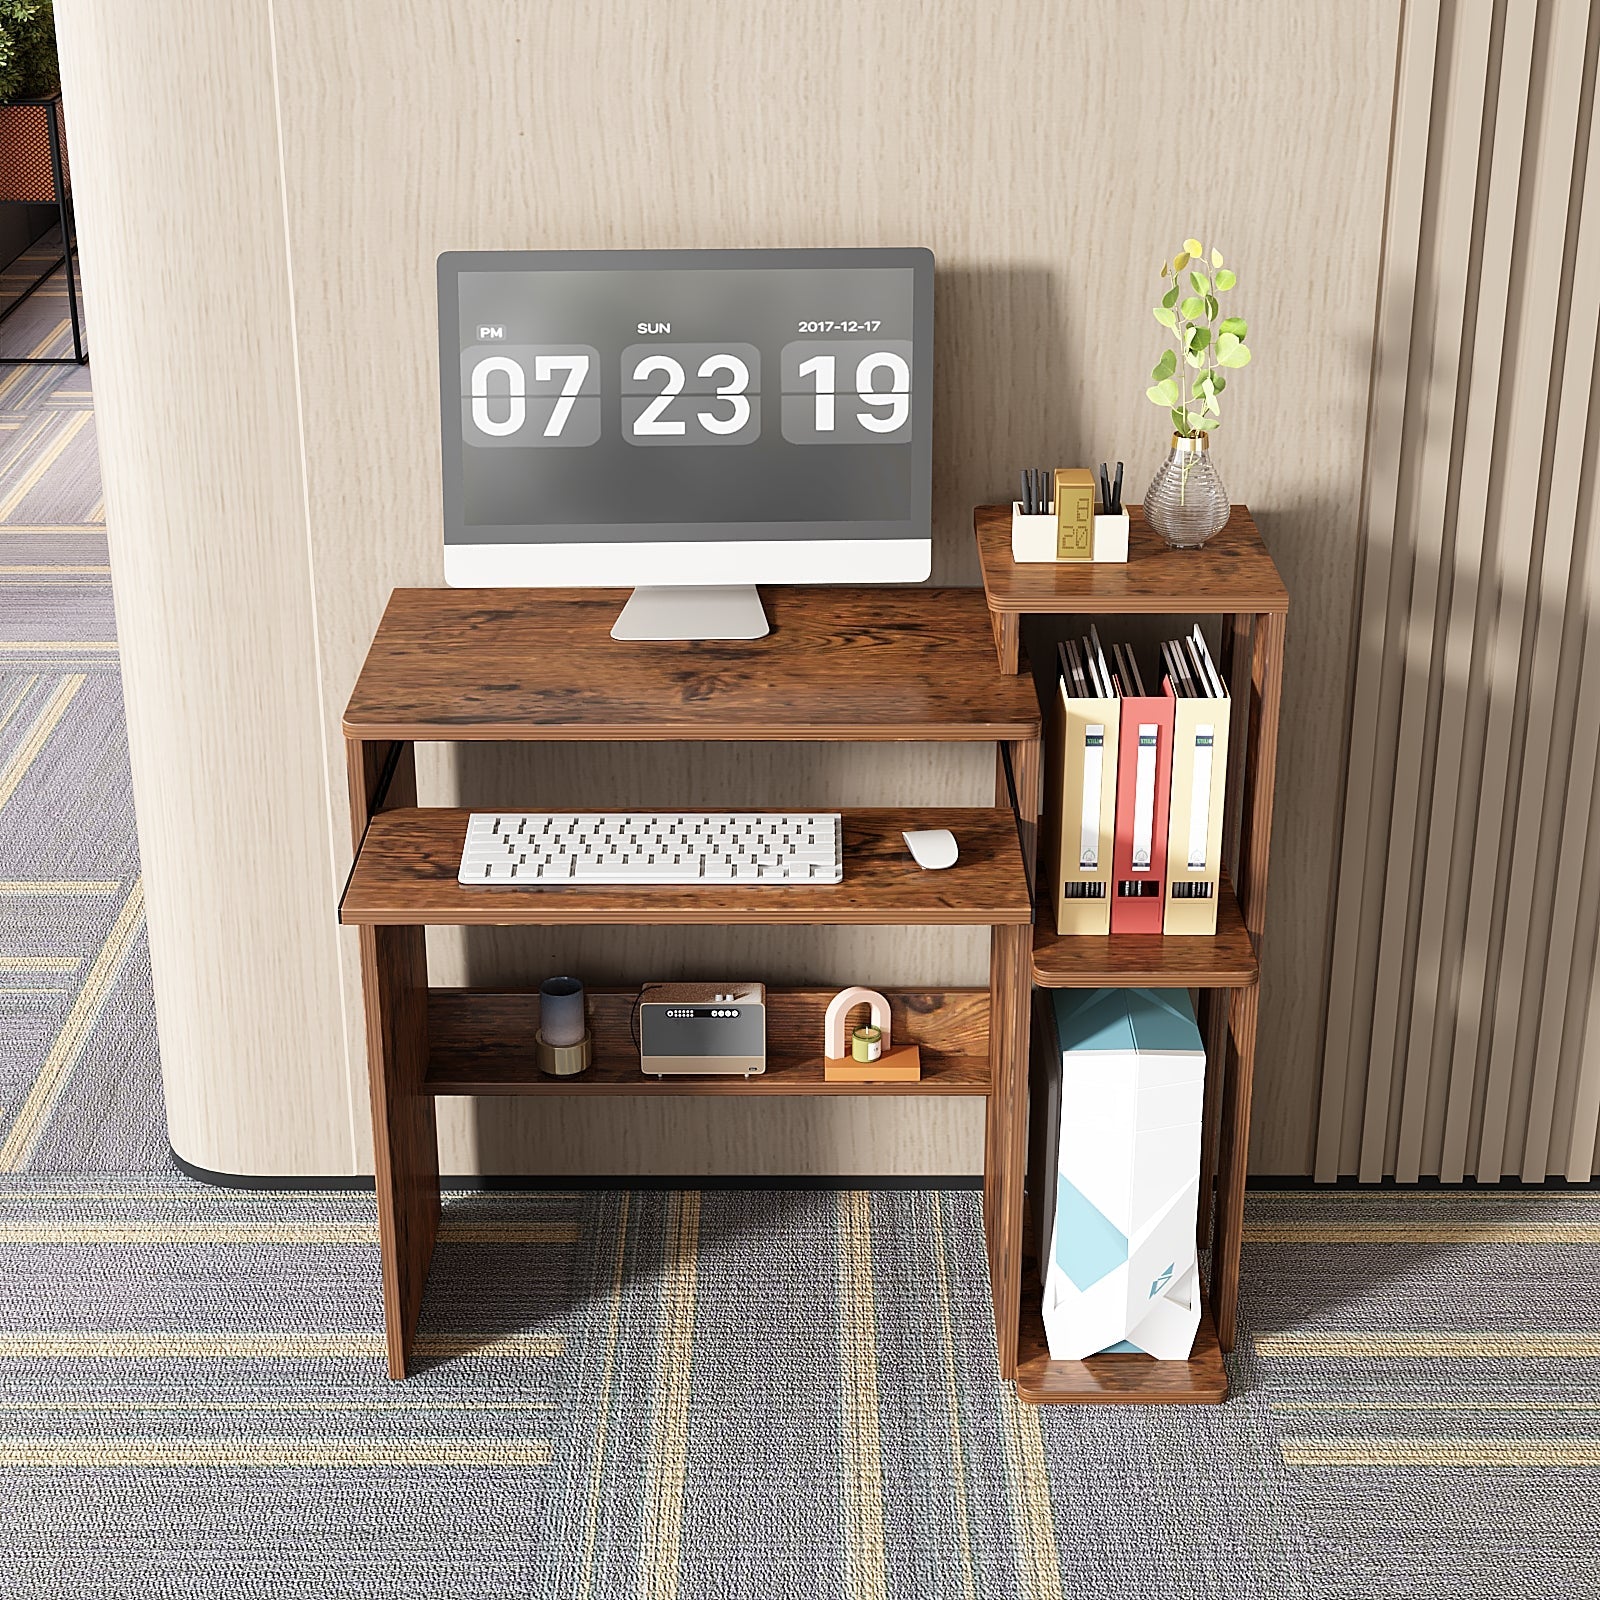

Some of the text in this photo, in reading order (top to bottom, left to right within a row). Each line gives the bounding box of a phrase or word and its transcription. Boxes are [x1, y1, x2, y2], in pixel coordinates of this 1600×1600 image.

[480, 327, 503, 338] PM
[637, 322, 671, 334] SUN
[797, 320, 882, 333] 2017-12-17
[472, 352, 910, 436] 07 23 19
